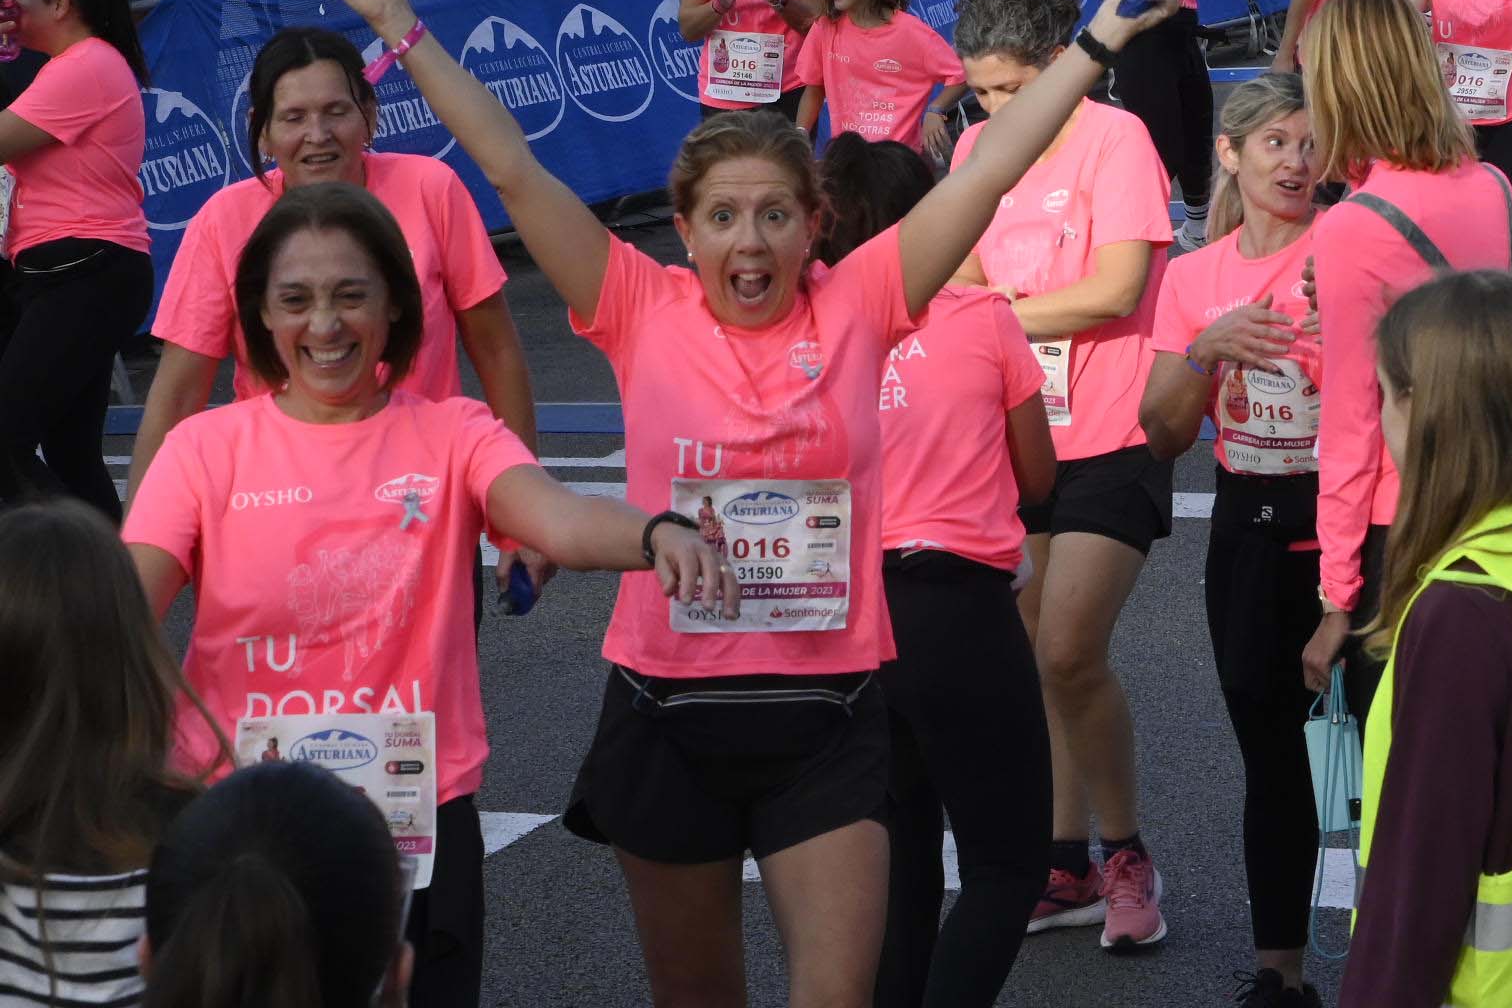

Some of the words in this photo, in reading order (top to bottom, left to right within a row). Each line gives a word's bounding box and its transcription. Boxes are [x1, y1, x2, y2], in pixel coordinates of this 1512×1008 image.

[731, 59, 756, 70] 016
[564, 52, 650, 96] ASTURIANA
[732, 71, 753, 79] 25146
[1458, 74, 1484, 87] 016
[873, 102, 895, 111] POR
[859, 112, 894, 122] TODAS
[1251, 372, 1291, 389] ASTURIANA
[1253, 401, 1294, 421] 016
[1269, 425, 1276, 435] 3
[674, 438, 722, 476] TU
[1228, 449, 1261, 464] OYSHO
[231, 487, 313, 510] OYSHO
[806, 496, 839, 504] SUMA
[729, 504, 793, 517] ASTURIANA
[733, 538, 790, 558] 016
[738, 567, 783, 579] 31590
[773, 587, 807, 595] MUJER
[811, 587, 833, 595] 2023
[784, 606, 838, 618] Santander
[236, 633, 296, 673] TU
[385, 738, 421, 747] SUMA
[296, 746, 370, 761] ASTURIANA
[394, 841, 416, 850] 023
